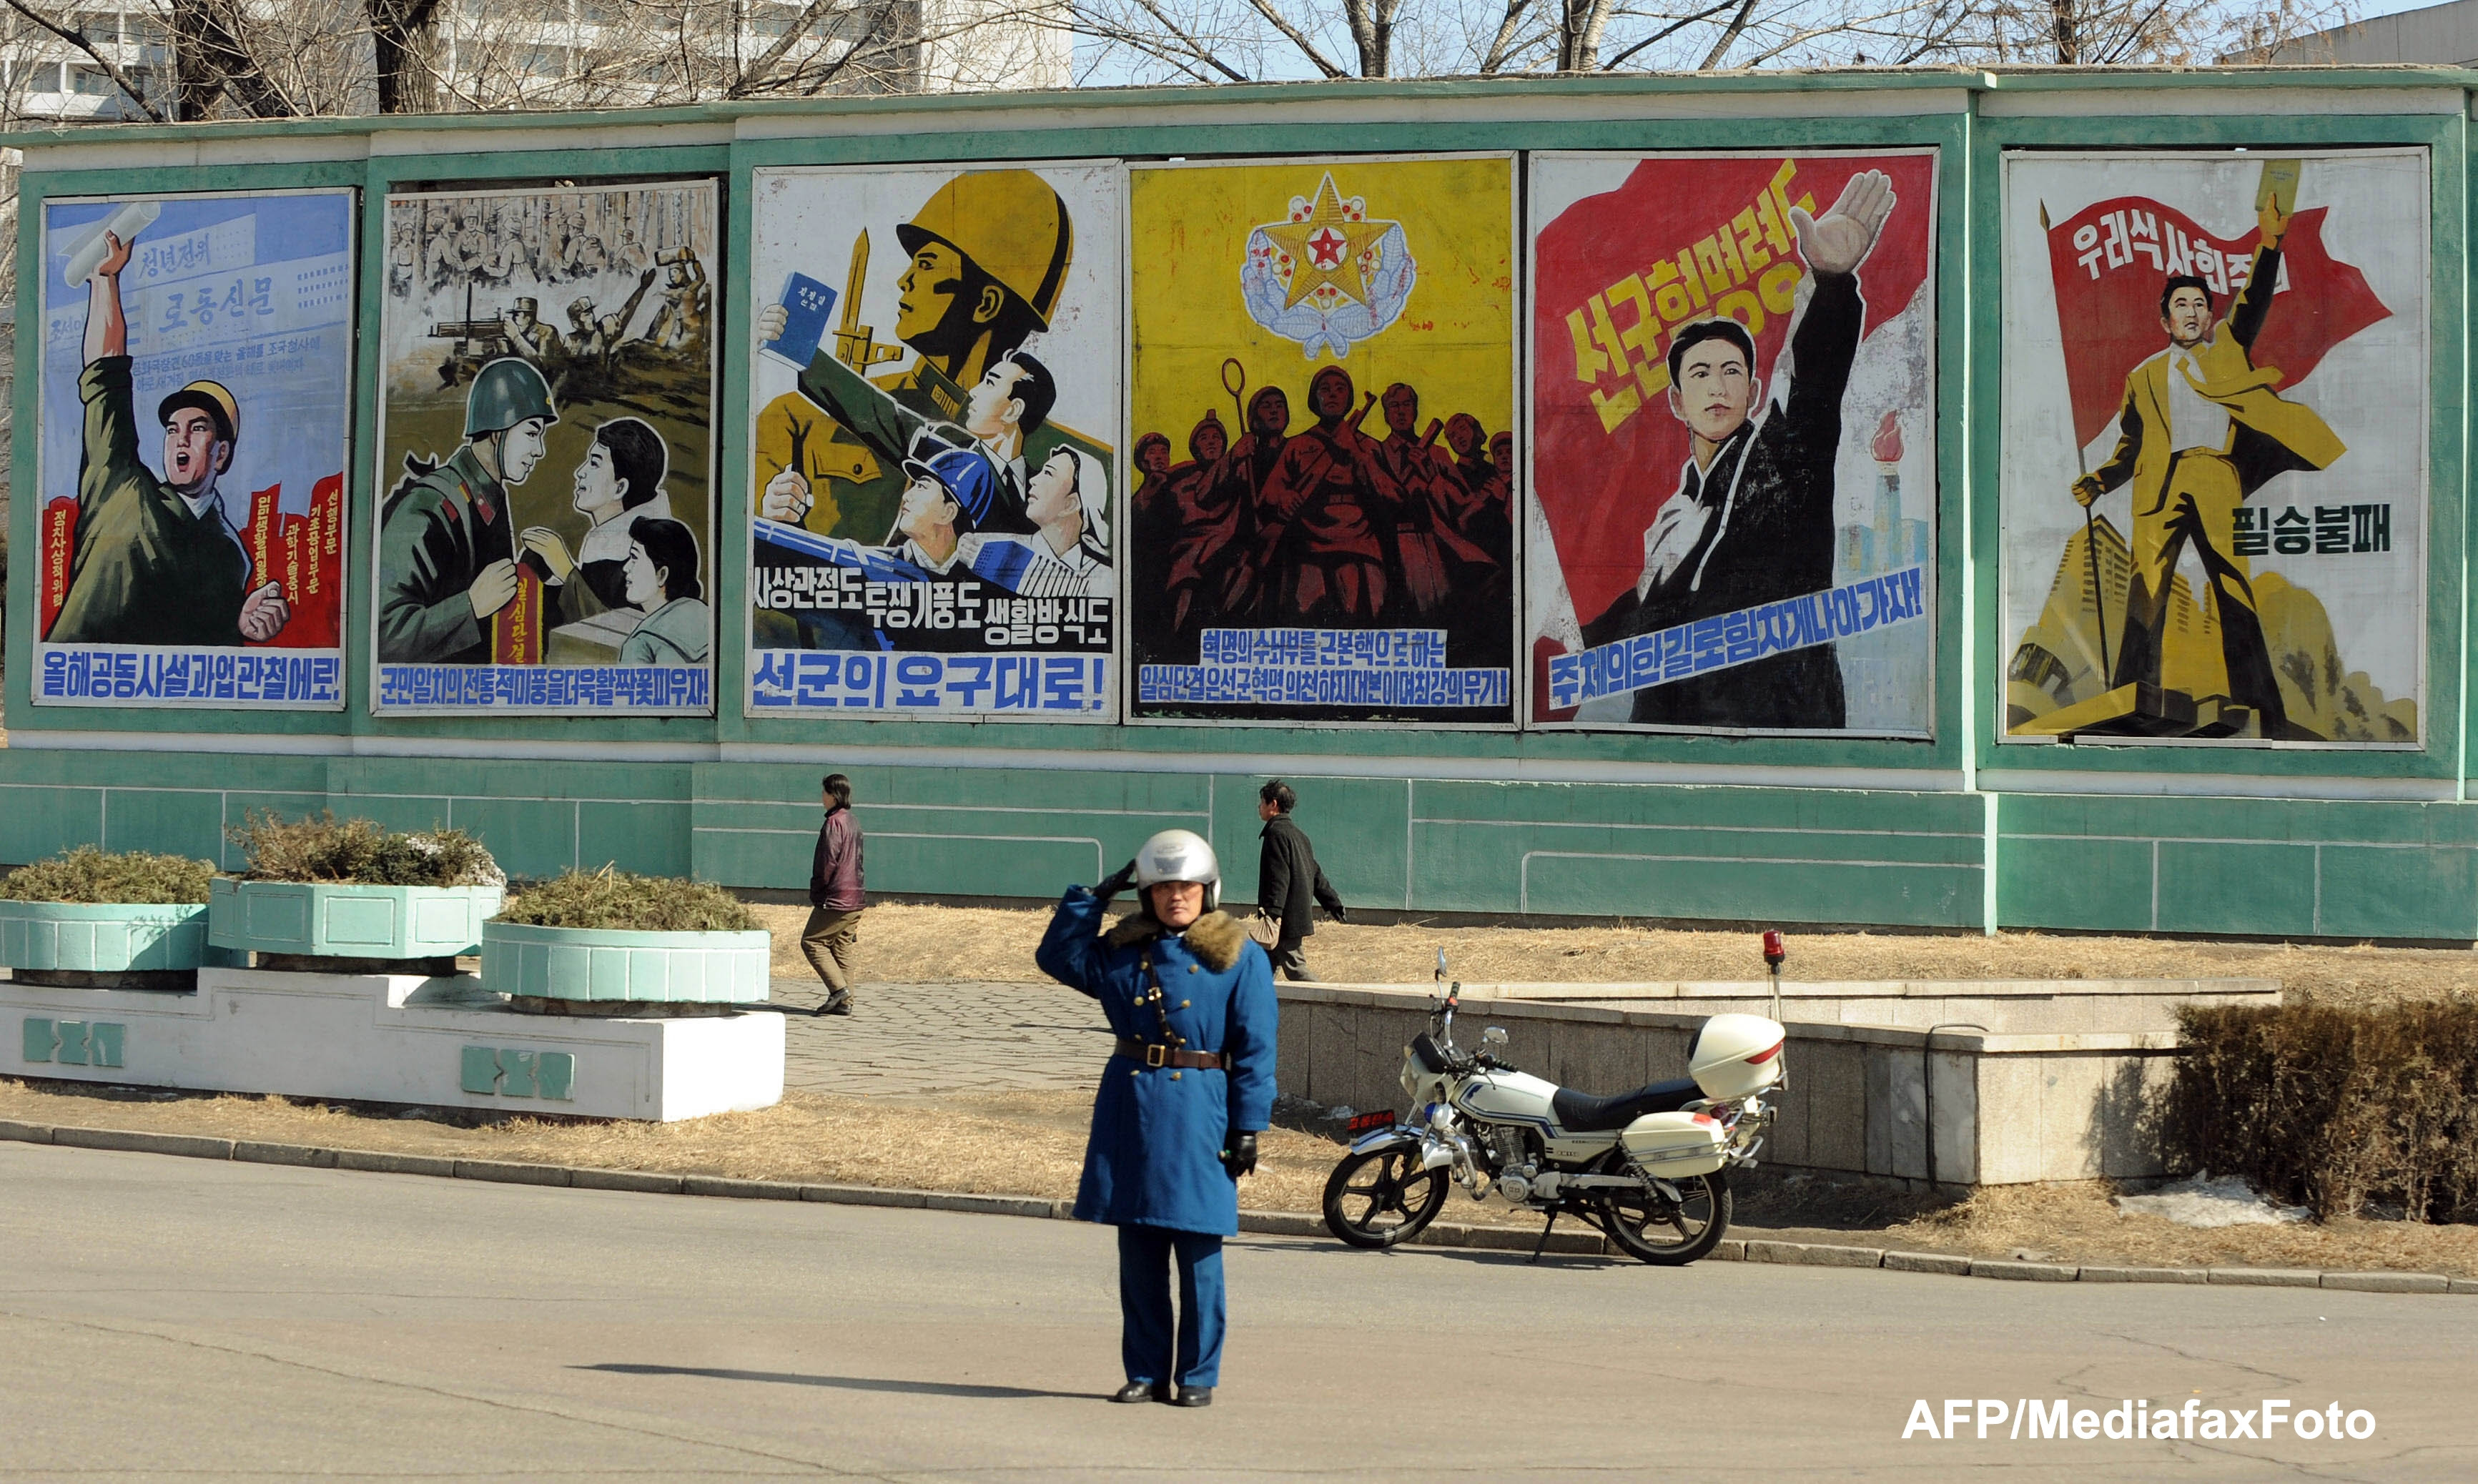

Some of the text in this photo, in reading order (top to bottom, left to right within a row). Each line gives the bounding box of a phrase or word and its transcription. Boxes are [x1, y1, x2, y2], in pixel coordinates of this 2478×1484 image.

[158, 277, 275, 333] 로동신문
[2231, 503, 2391, 556] 필승불패
[507, 577, 528, 663] 일심단결
[865, 581, 981, 629] 투쟁기풍도
[753, 653, 887, 708] 선군의
